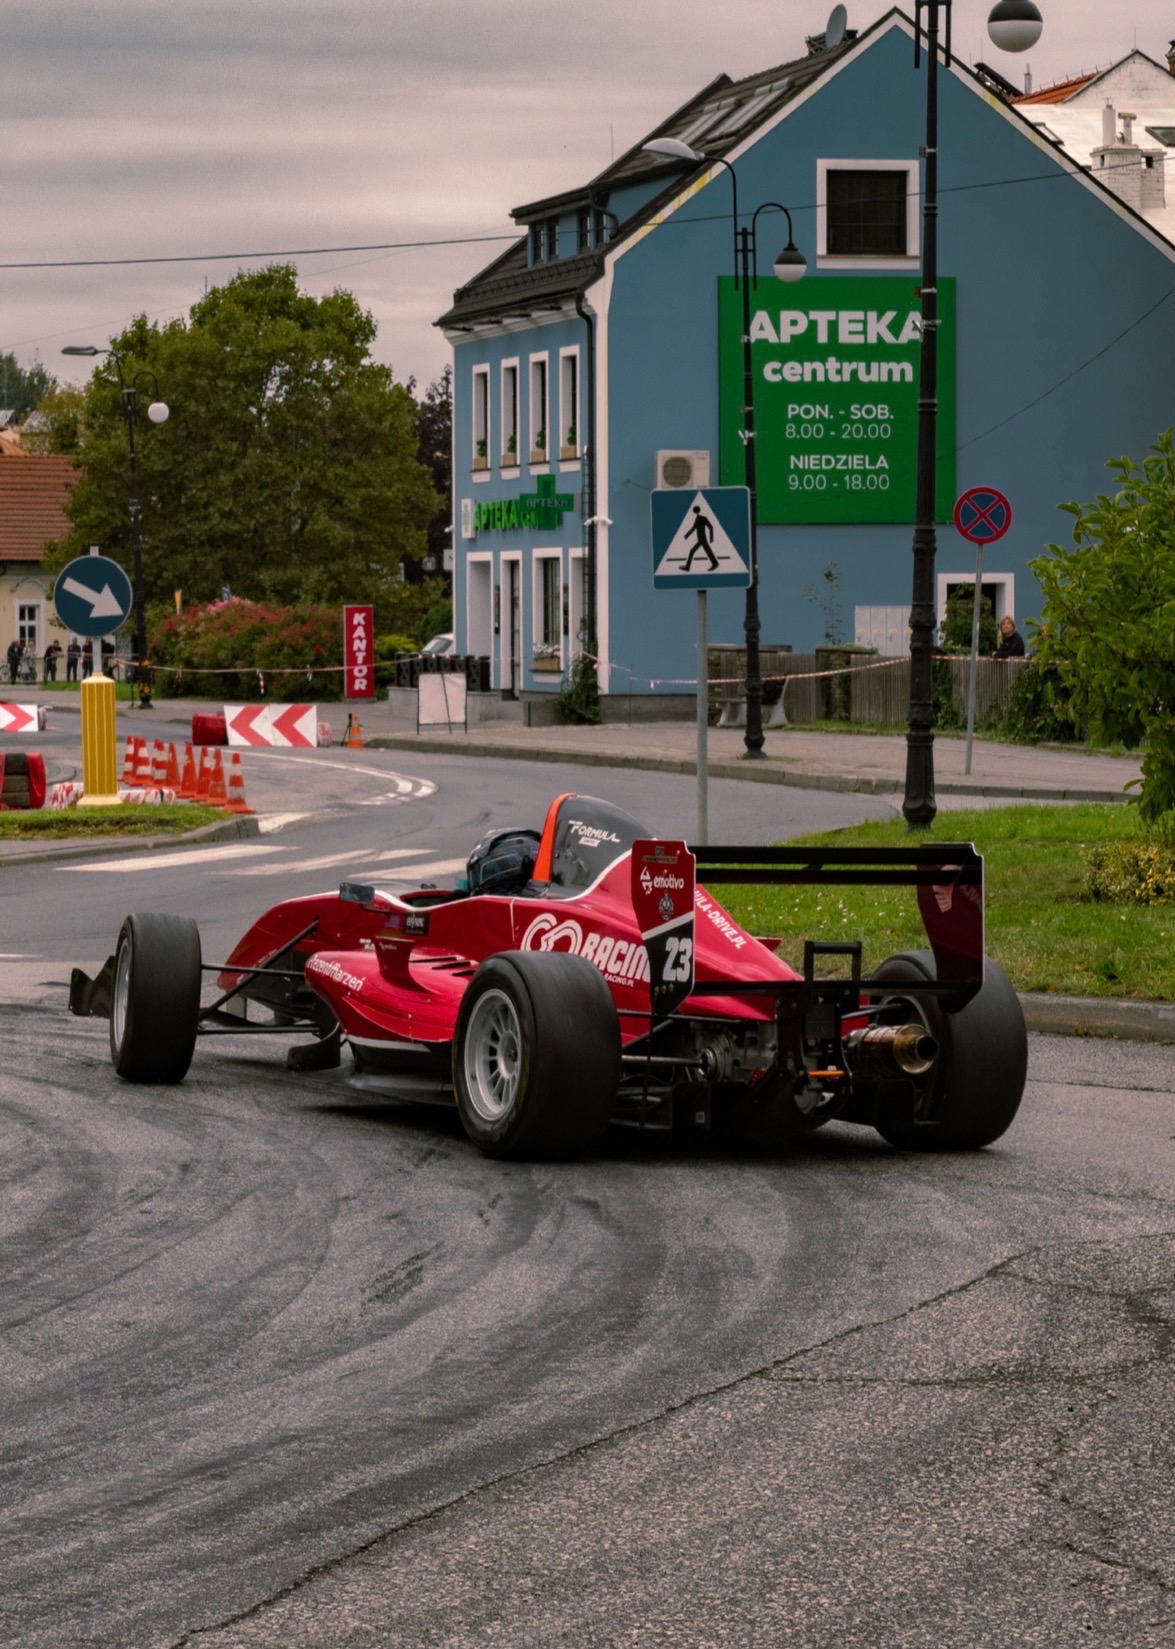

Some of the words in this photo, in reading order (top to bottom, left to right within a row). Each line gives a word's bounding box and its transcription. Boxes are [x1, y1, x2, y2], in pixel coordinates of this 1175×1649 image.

[750, 310, 923, 344] APTEKA
[763, 357, 913, 382] centrum
[788, 404, 834, 420] PON.
[850, 404, 895, 420] SOB.
[785, 423, 824, 439] 8.00
[841, 423, 891, 439] 20.00
[790, 455, 889, 470] NIEDZIELA
[788, 475, 827, 490] 9.00
[844, 475, 890, 490] 18.00
[526, 497, 568, 508] APTEKA
[474, 500, 518, 532] APTEKA
[352, 612, 368, 691] KANTOR
[568, 820, 621, 843] FORMULA
[653, 874, 685, 890] emotivo
[577, 932, 651, 983] RACIN
[662, 936, 693, 982] 23
[602, 972, 635, 988] RACING.PL
